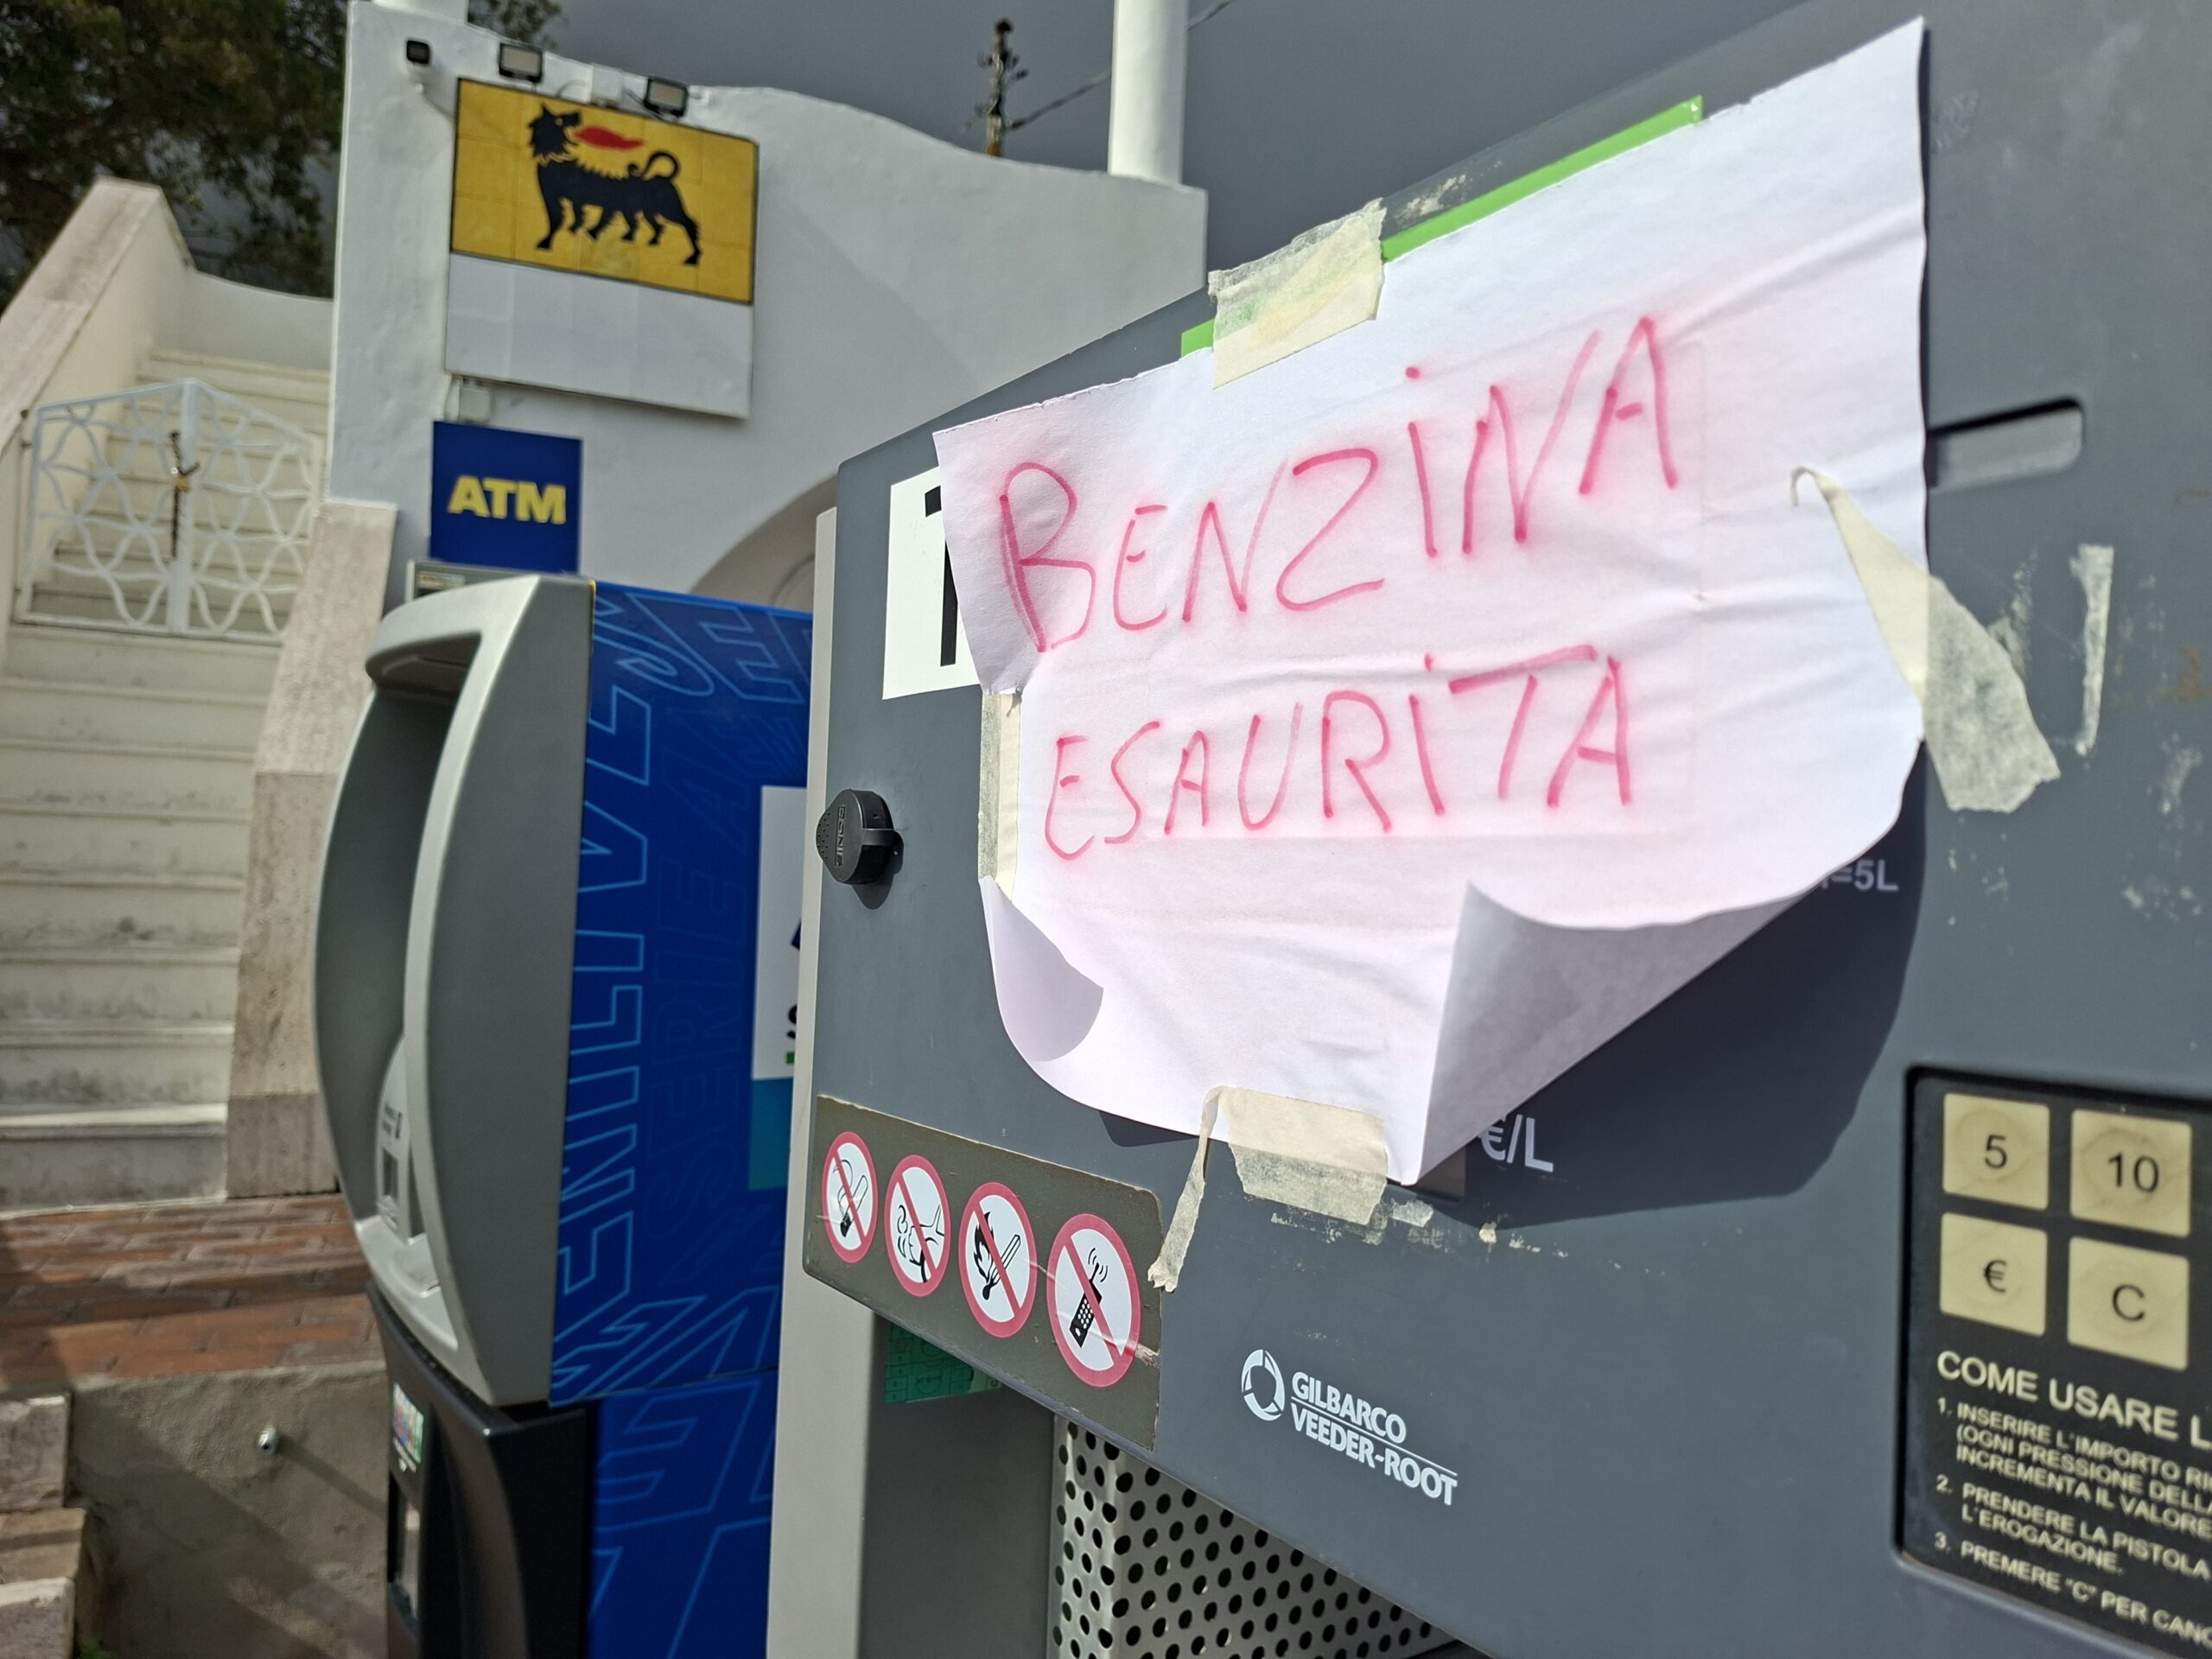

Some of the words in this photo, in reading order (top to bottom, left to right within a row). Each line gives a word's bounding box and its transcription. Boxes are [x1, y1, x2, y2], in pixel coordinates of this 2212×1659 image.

[447, 474, 567, 524] ATM
[999, 316, 1679, 653] BENZINA
[1044, 644, 1632, 861] ESAURITA
[1478, 1113, 1554, 1173] €/L
[1984, 1134, 2008, 1170] 5
[2107, 1152, 2159, 1193] 10
[1983, 1259, 2009, 1294] €
[2111, 1283, 2146, 1323] C
[1292, 1371, 1407, 1444] GILBARCO
[1936, 1350, 2039, 1402] COME
[2049, 1377, 2180, 1442] USARE
[1290, 1402, 1459, 1506] VEEDER-ROOT
[1955, 1423, 2016, 1456] (OGNI
[2018, 1440, 2145, 1497] PRESSIONE
[1955, 1444, 2093, 1504] INCREMENTA
[2095, 1485, 2116, 1511] IL
[1956, 1401, 2053, 1446] INSERIRE
[2056, 1428, 2182, 1483] L'IMPORTO
[2184, 1465, 2212, 1494] RI
[1961, 1481, 2075, 1537] PRENDERE
[2079, 1519, 2110, 1548] LA
[2112, 1530, 2212, 1584] PISTOLA
[1960, 1540, 2063, 1594] PREMERE
[2100, 1589, 2149, 1626] PER
